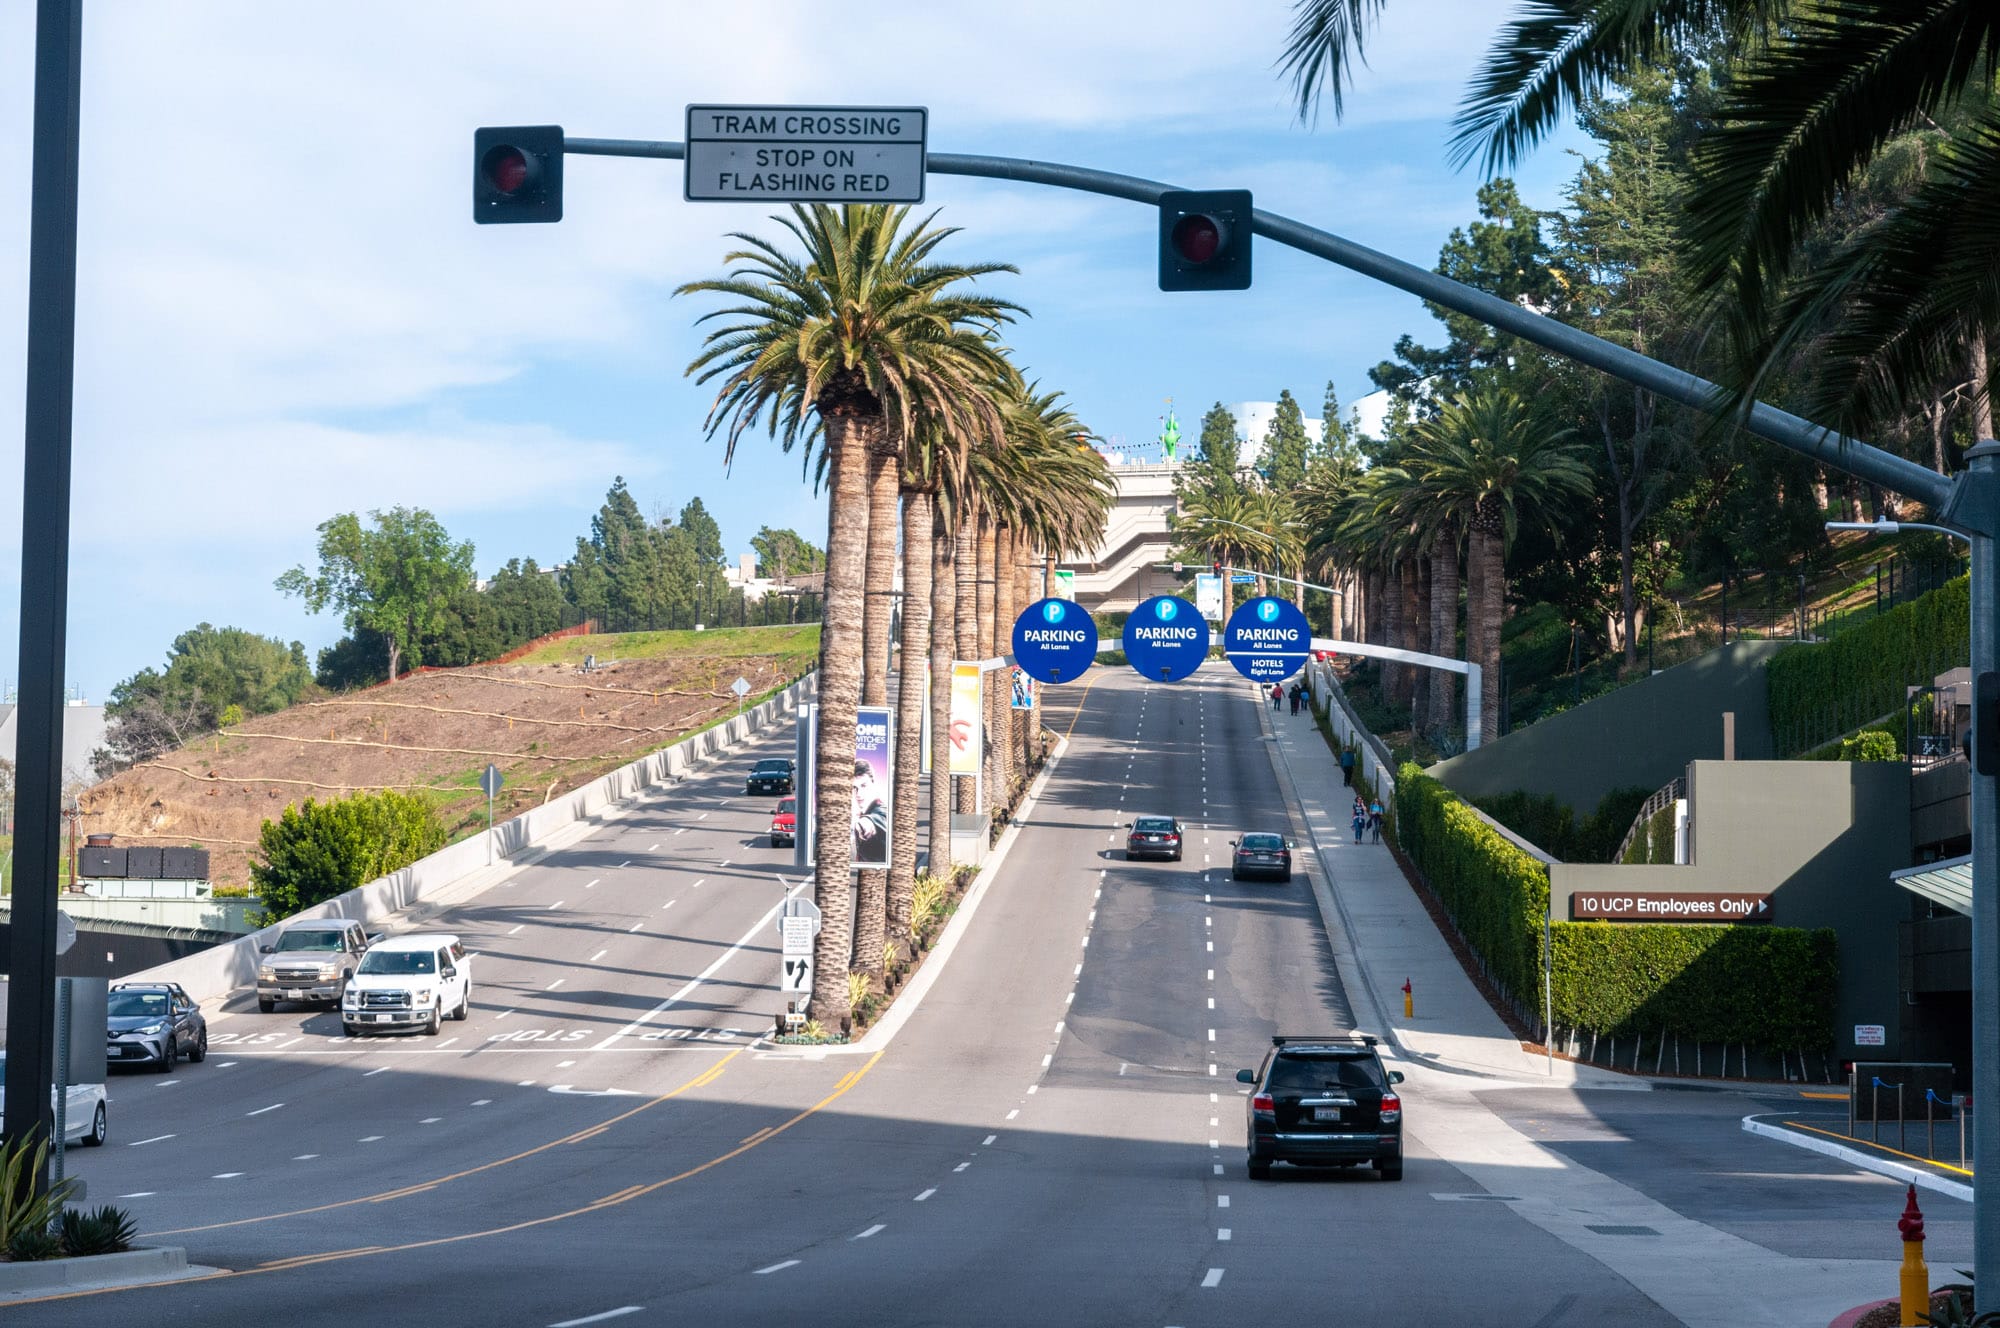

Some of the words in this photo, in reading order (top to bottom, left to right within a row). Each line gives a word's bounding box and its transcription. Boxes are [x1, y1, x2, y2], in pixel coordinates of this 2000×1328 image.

[712, 116, 776, 134] TRAM
[784, 116, 901, 135] CROSSING
[756, 149, 815, 167] STOP
[823, 150, 854, 167] ON
[718, 172, 835, 191] FLASHING
[843, 175, 890, 192] RED
[1024, 630, 1086, 642] PARKING
[1135, 628, 1197, 640] PARKING
[1236, 628, 1298, 641] PARKING
[1252, 660, 1283, 668] HOTELS
[1251, 668, 1267, 677] Right
[1581, 898, 1598, 911] 10
[1602, 899, 1633, 912] UCP
[1637, 899, 1715, 915] Employees
[1720, 900, 1754, 915] Only
[487, 1030, 593, 1042] STOP
[639, 1028, 741, 1040] STOP
